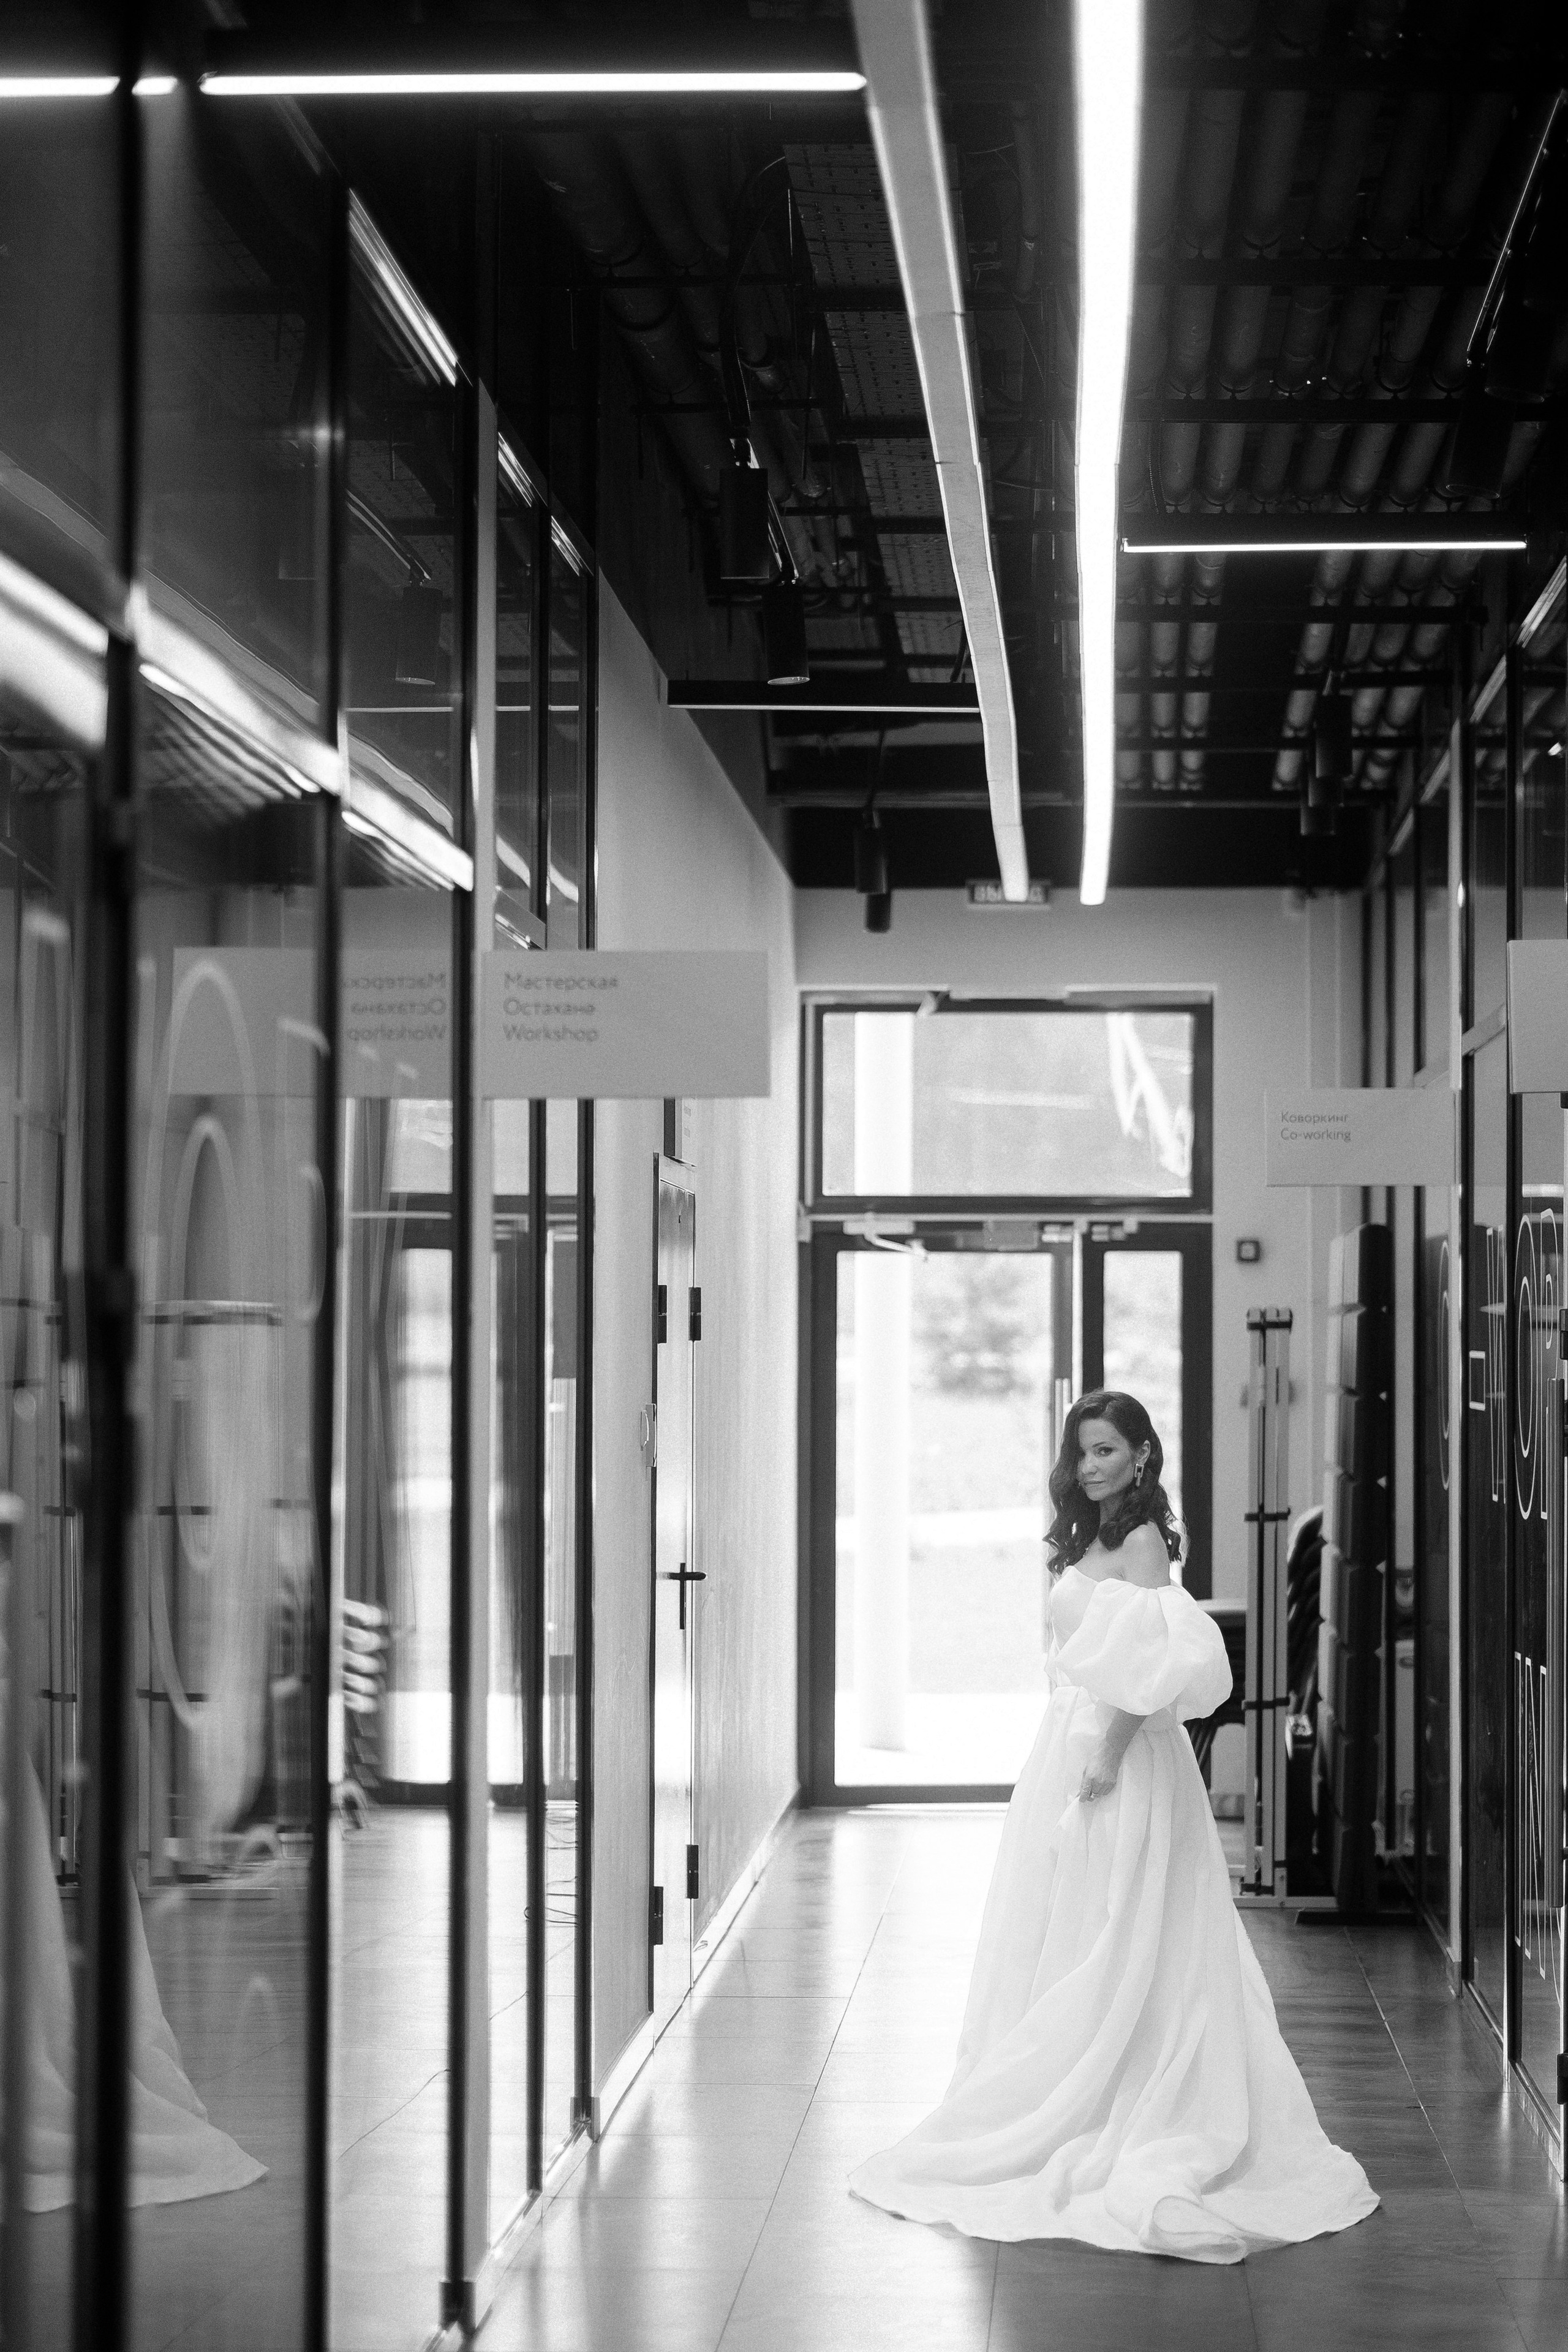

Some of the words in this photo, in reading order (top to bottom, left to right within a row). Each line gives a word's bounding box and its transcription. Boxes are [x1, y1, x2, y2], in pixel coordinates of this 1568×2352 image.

[503, 971, 619, 991] Мастерская
[502, 1023, 600, 1044] Workshop
[1280, 1110, 1349, 1126] Коворкинг
[1280, 1127, 1351, 1144] Co-working
